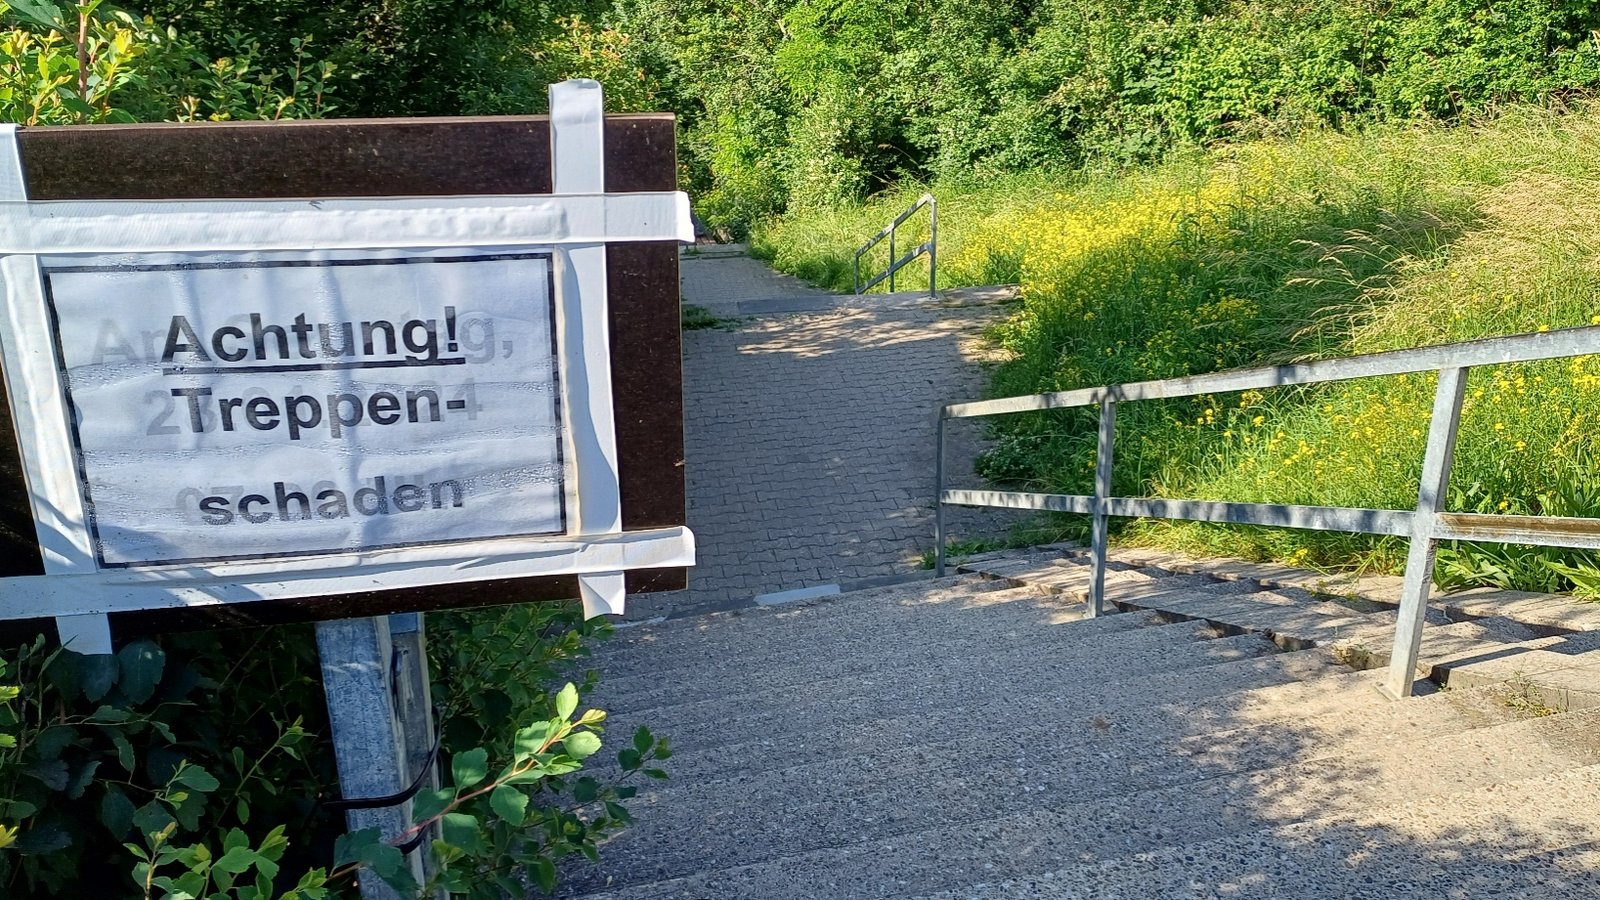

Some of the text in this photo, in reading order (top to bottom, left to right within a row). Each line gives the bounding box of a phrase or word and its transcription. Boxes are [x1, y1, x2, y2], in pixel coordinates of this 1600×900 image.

[161, 306, 457, 366] Achtung!
[171, 387, 466, 440] Treppen-
[198, 476, 464, 526] schaden
